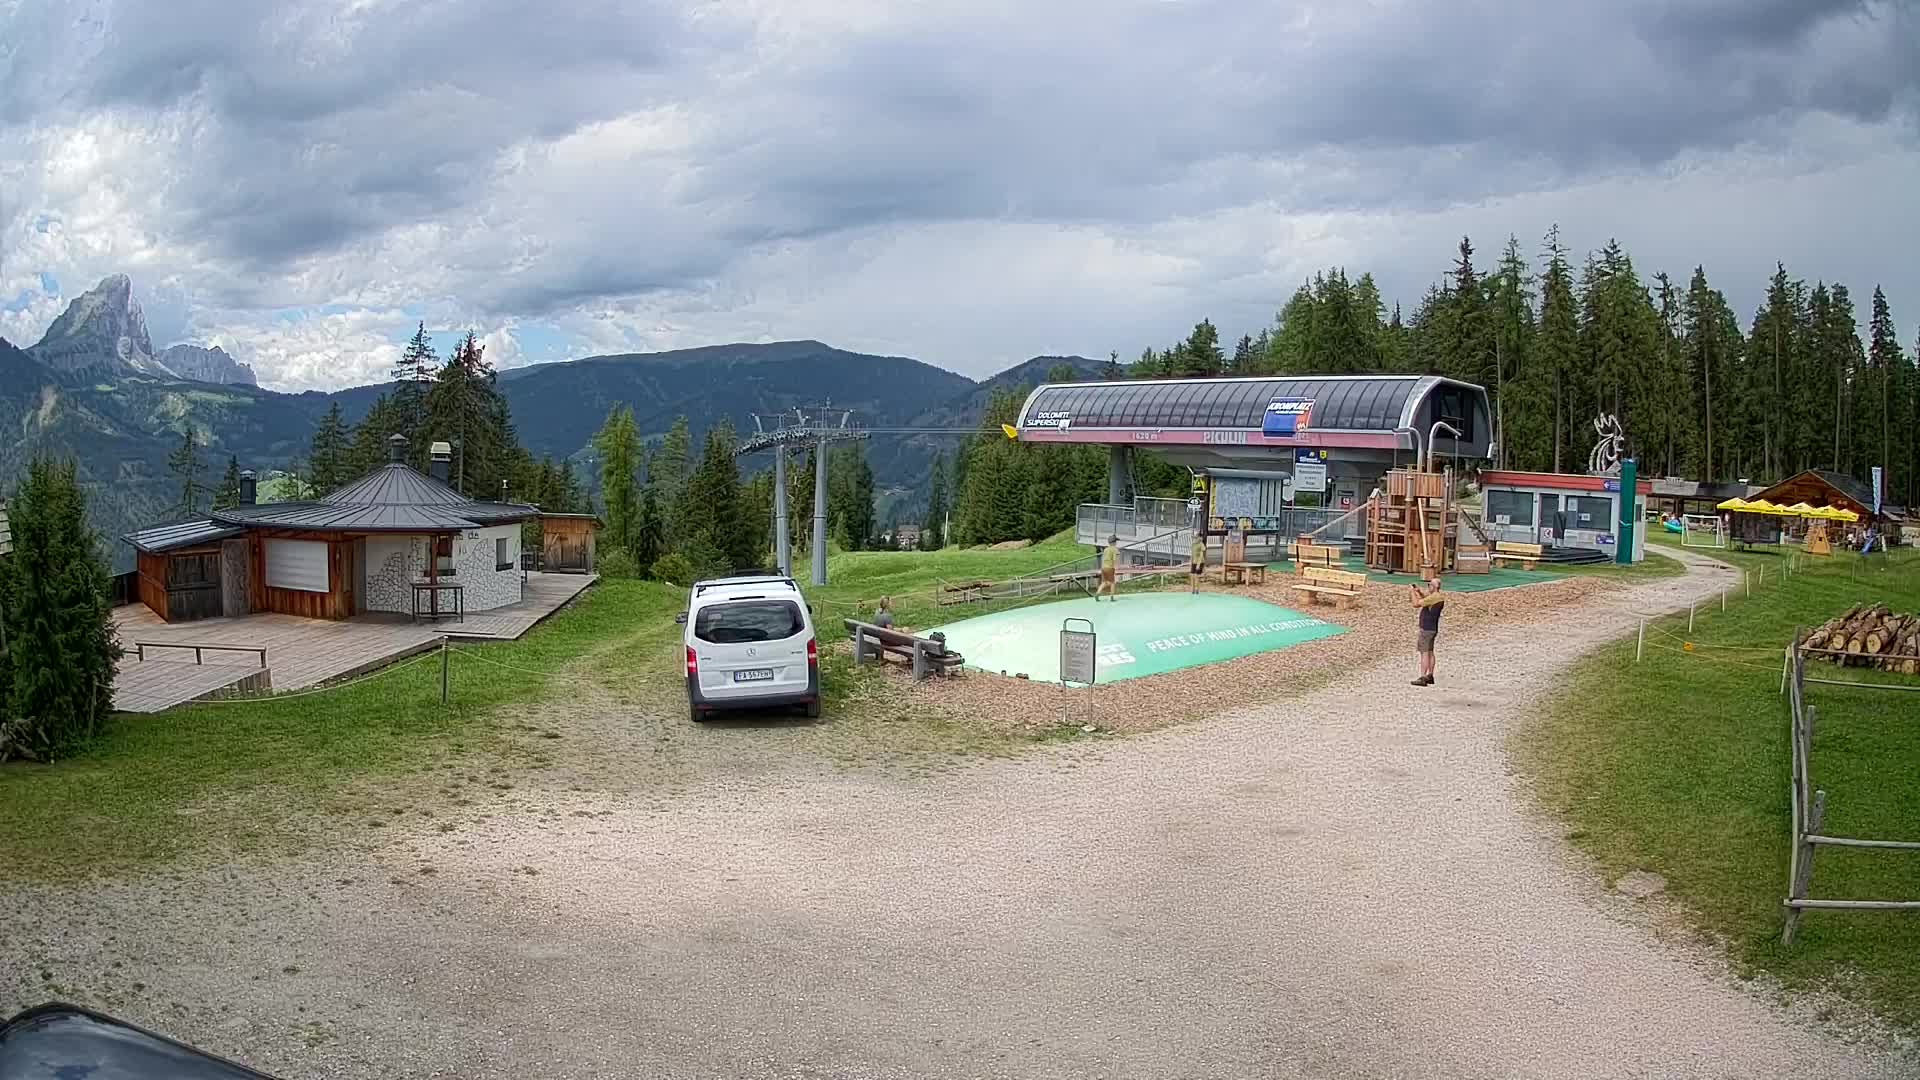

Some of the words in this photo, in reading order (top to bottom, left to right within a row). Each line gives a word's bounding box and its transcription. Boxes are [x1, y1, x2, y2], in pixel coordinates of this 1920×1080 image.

[1203, 430, 1247, 445] PICULIN
[1146, 635, 1190, 653] PEACE
[1189, 632, 1205, 644] OF
[1206, 629, 1237, 641] MIND
[1235, 626, 1251, 637] IN
[1250, 622, 1272, 635] ALL
